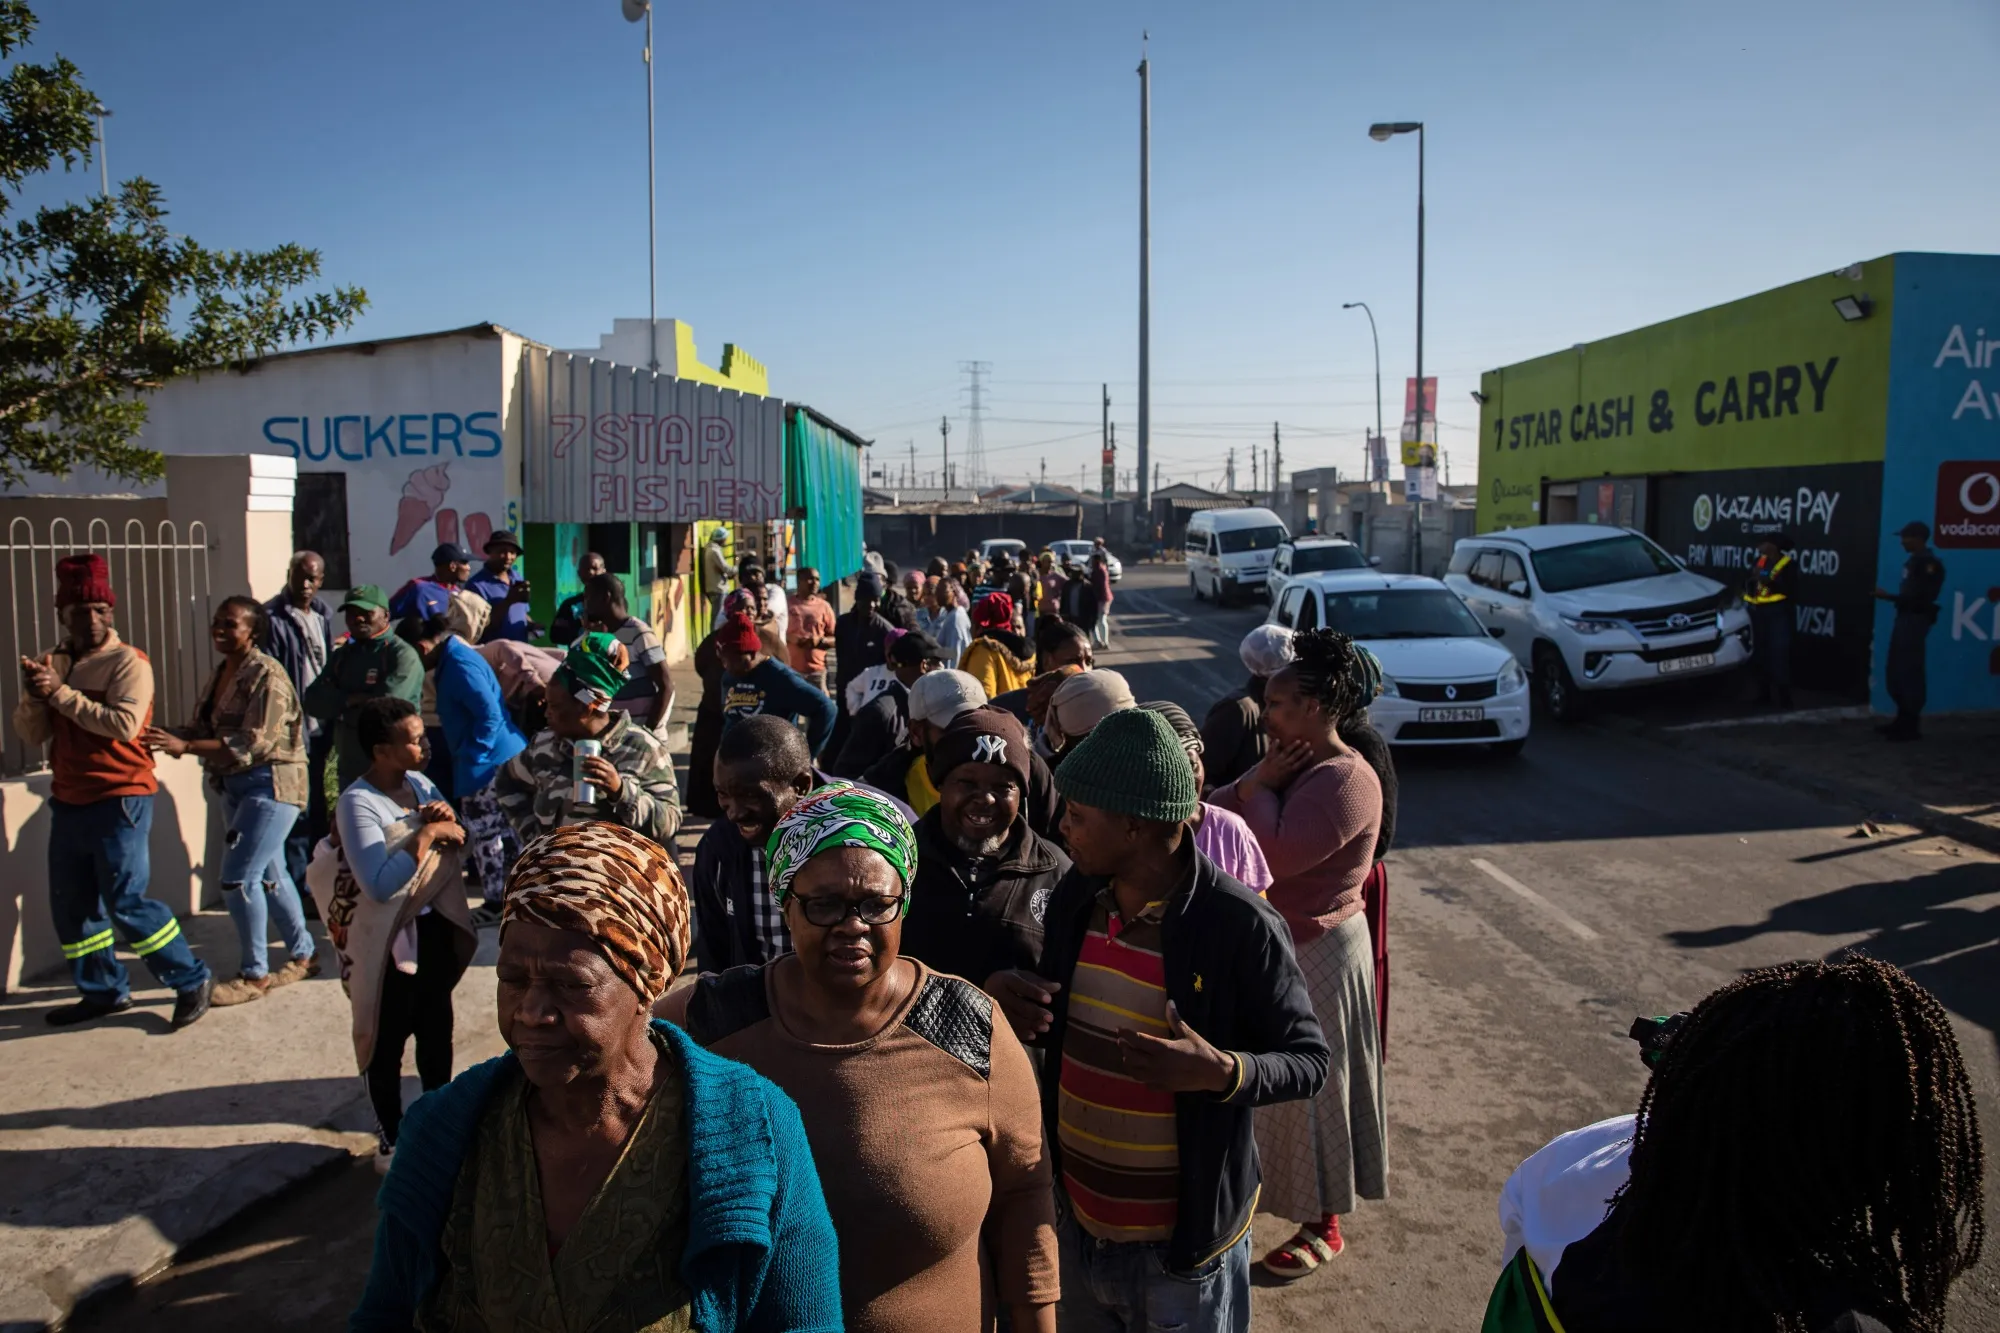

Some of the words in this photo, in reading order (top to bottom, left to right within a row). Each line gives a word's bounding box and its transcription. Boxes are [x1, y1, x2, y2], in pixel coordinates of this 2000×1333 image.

[1509, 409, 1562, 450] STAR
[1570, 395, 1634, 442] CASH
[1648, 389, 1674, 434] &
[1695, 356, 1840, 426] CARRY
[263, 412, 503, 461] SUCKERS
[551, 414, 586, 458] 7
[593, 413, 734, 466] STAR
[593, 474, 783, 520] FISHERY
[1716, 493, 1793, 525] KAZANG
[1796, 486, 1841, 535] PAY
[1688, 544, 1708, 567] PAY
[1711, 544, 1742, 568] WITH
[1799, 549, 1840, 576] CARD
[1795, 604, 1835, 638] VISA
